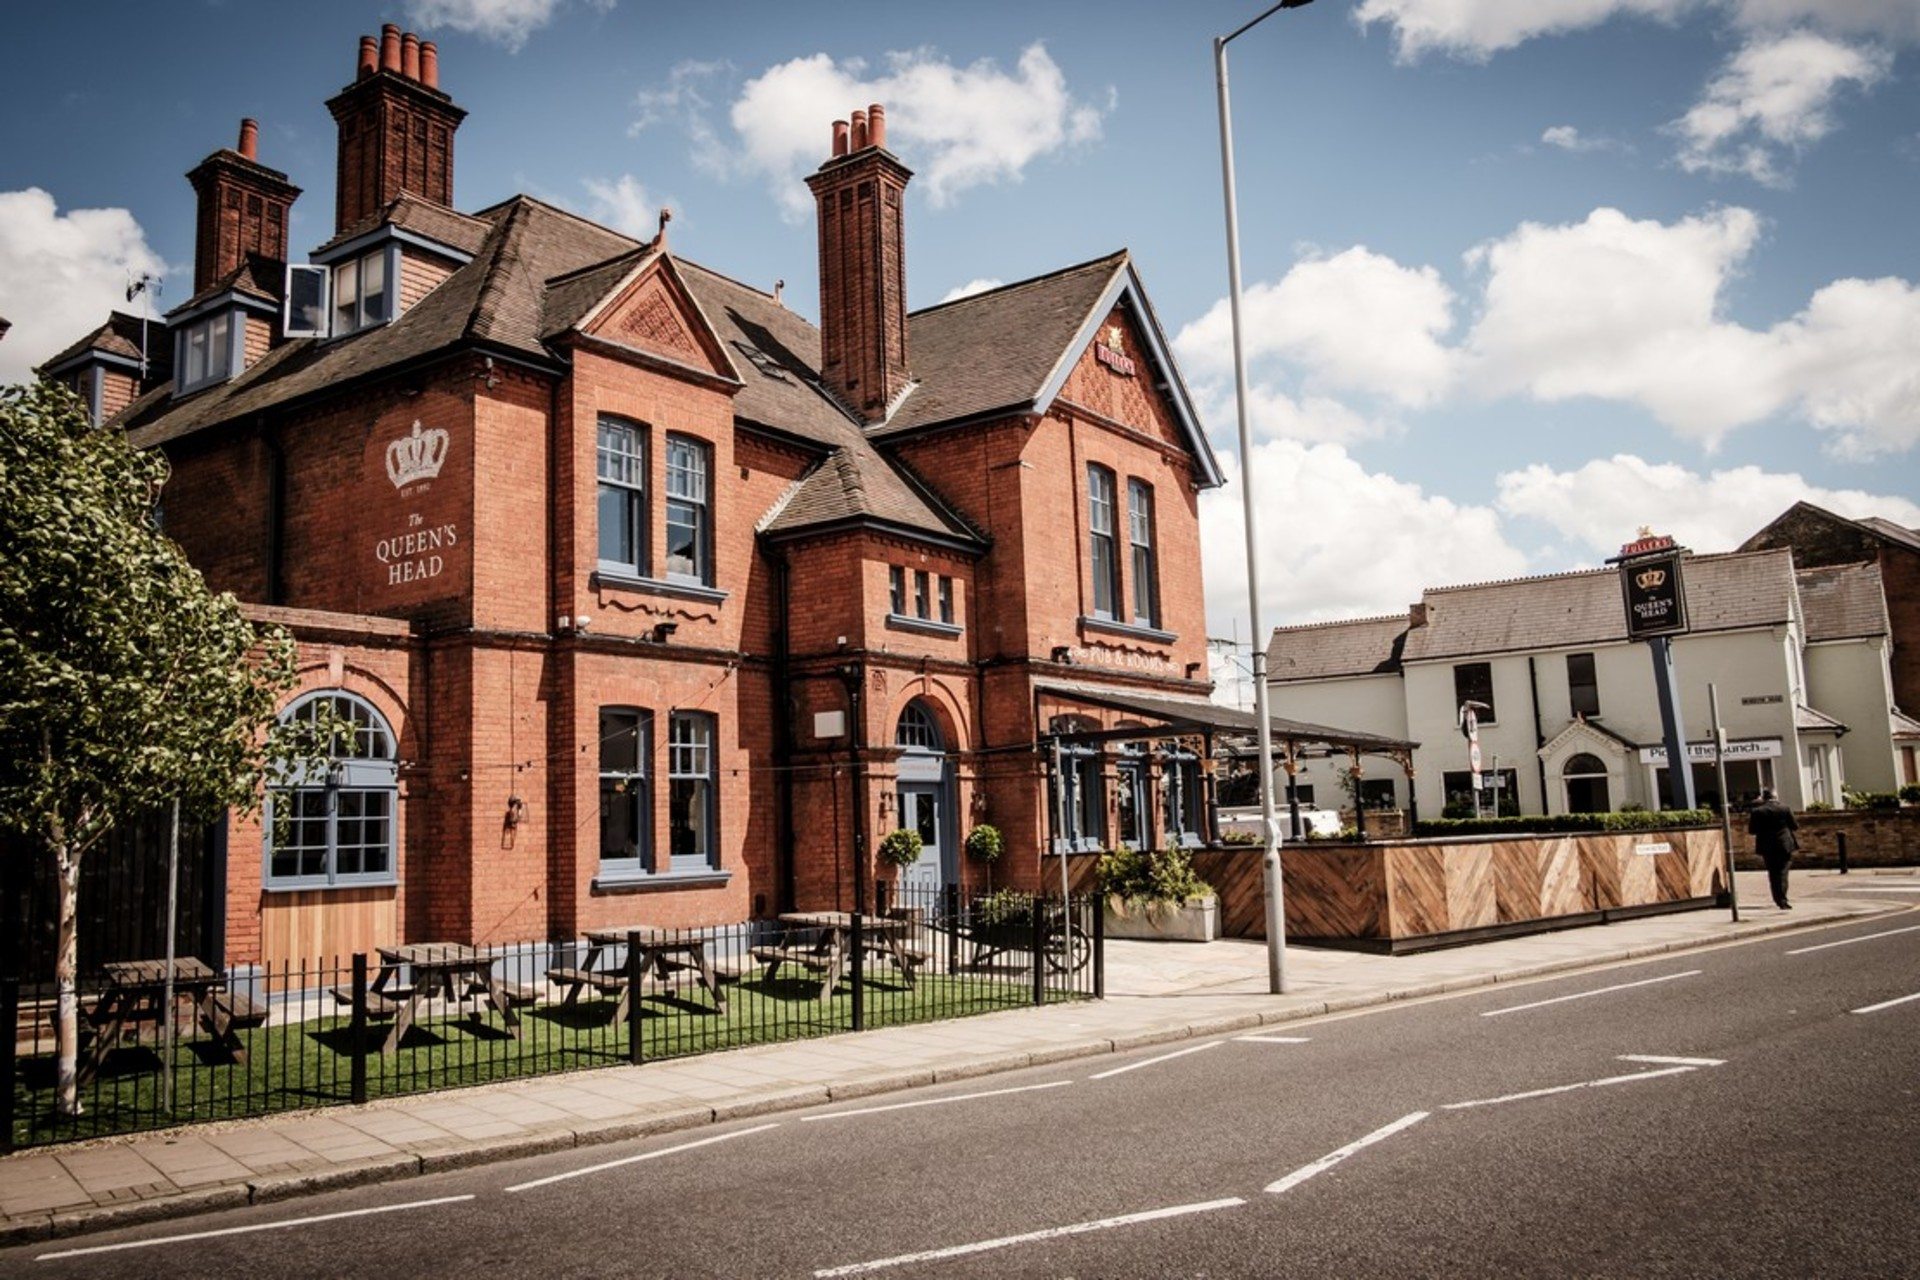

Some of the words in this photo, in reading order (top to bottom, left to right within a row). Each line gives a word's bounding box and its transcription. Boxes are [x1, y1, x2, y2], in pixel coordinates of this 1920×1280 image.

[409, 513, 423, 526] The
[376, 524, 456, 563] QUEEN'S
[388, 555, 443, 585] HEAD
[1722, 742, 1760, 754] unch
